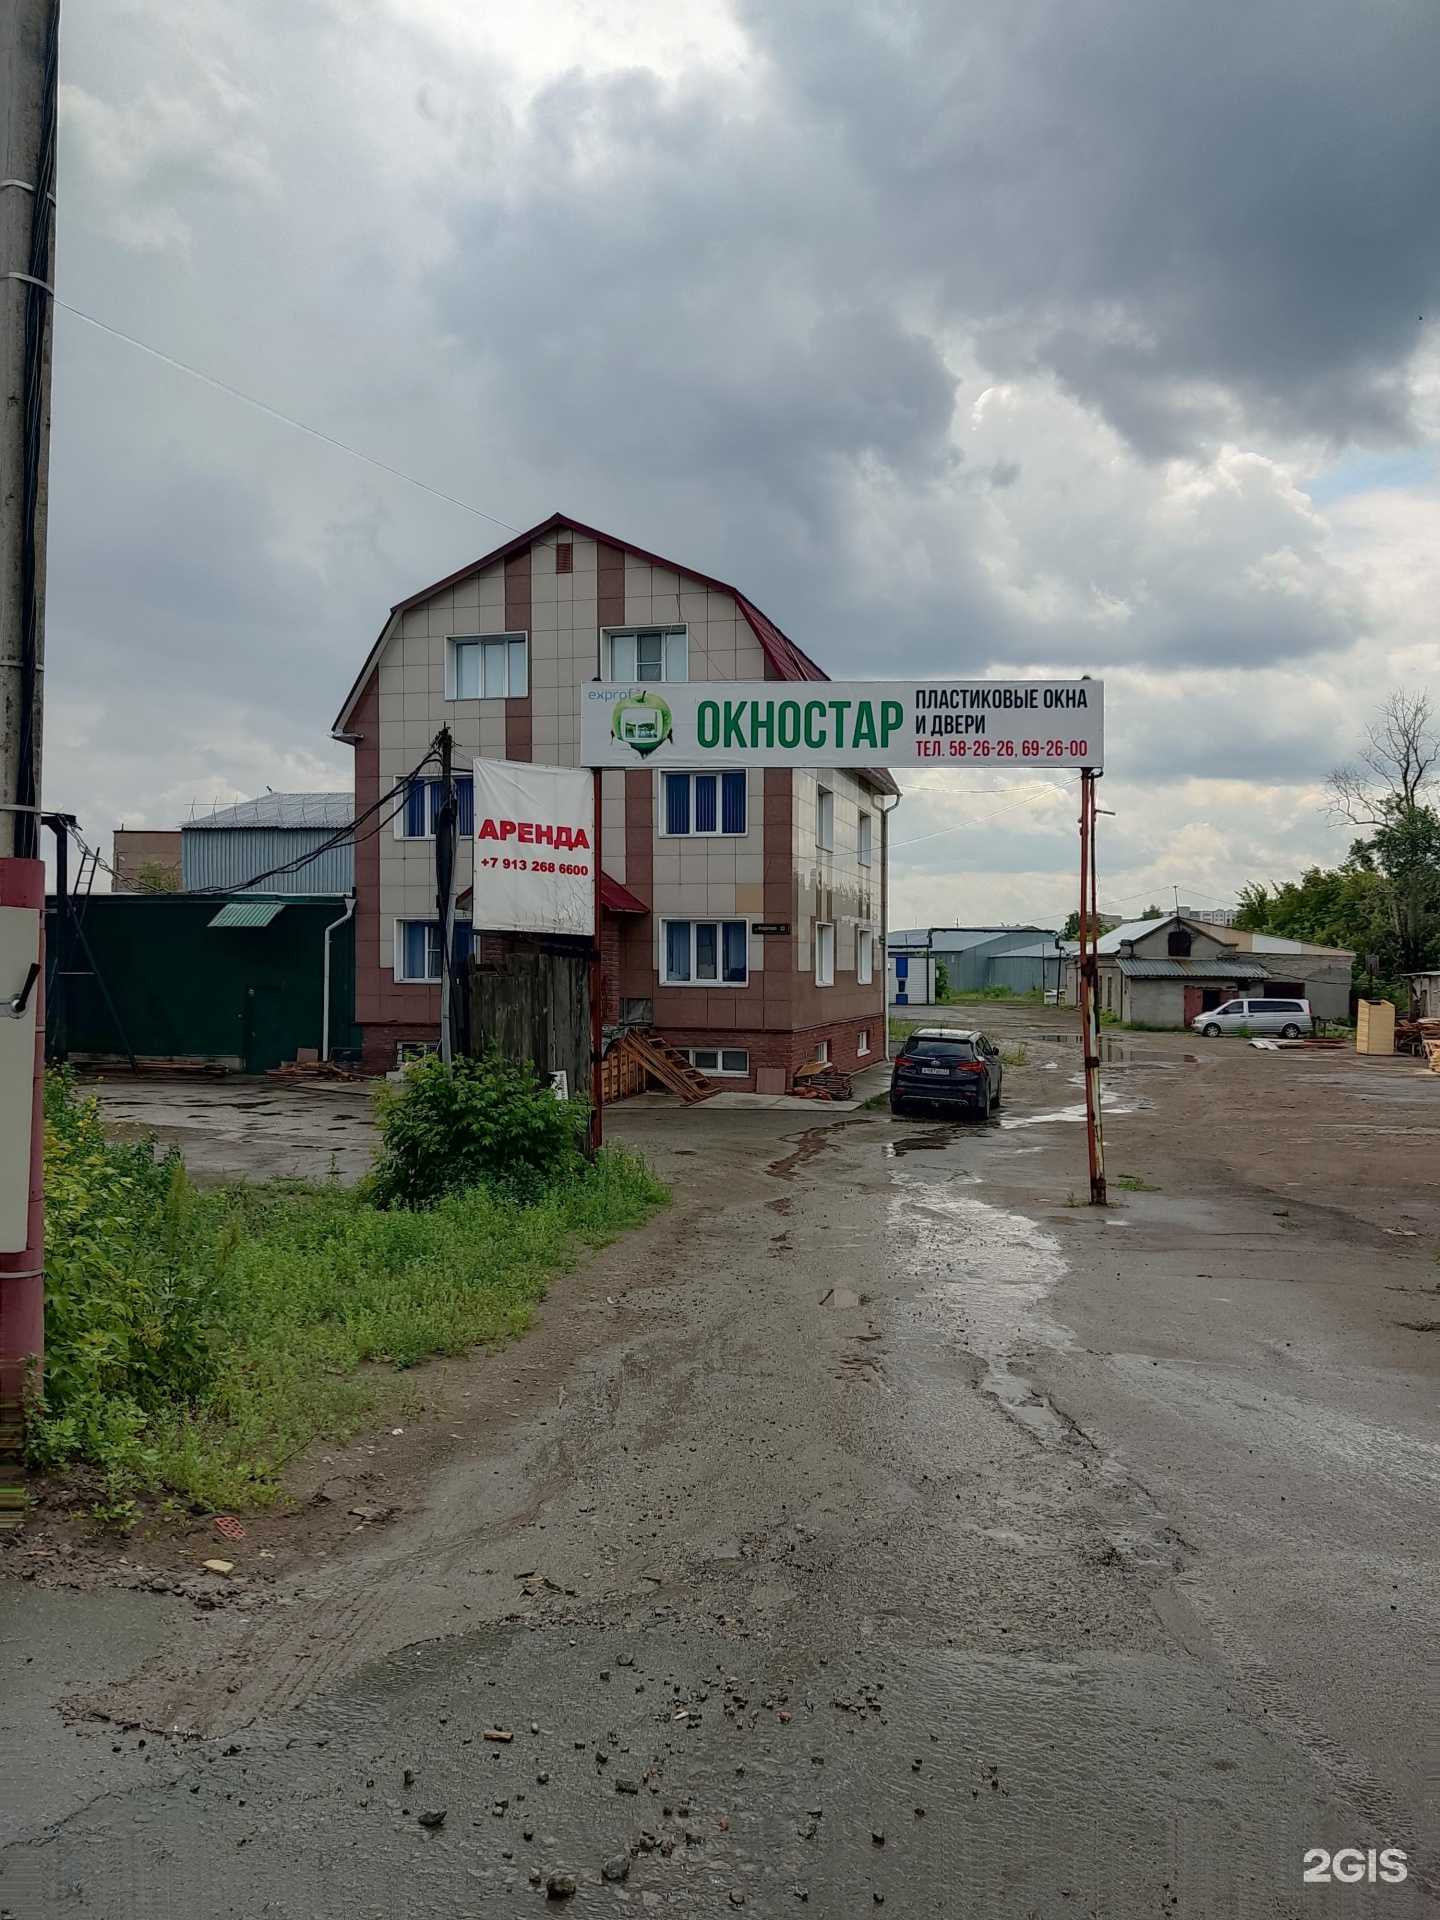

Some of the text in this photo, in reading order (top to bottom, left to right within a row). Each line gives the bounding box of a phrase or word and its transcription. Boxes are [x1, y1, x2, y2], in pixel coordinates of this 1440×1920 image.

[915, 688, 1088, 709] ПЛАСТИКОВЫЕ ОКНА
[697, 700, 904, 748] ОКНОСТАР
[915, 715, 986, 737] И ДВЕРИ
[915, 739, 1088, 758] ТЕЛ. 58-26-26, 69-26-00
[479, 819, 590, 851] АРЕНДА
[481, 857, 589, 876] +7 913 268 6600
